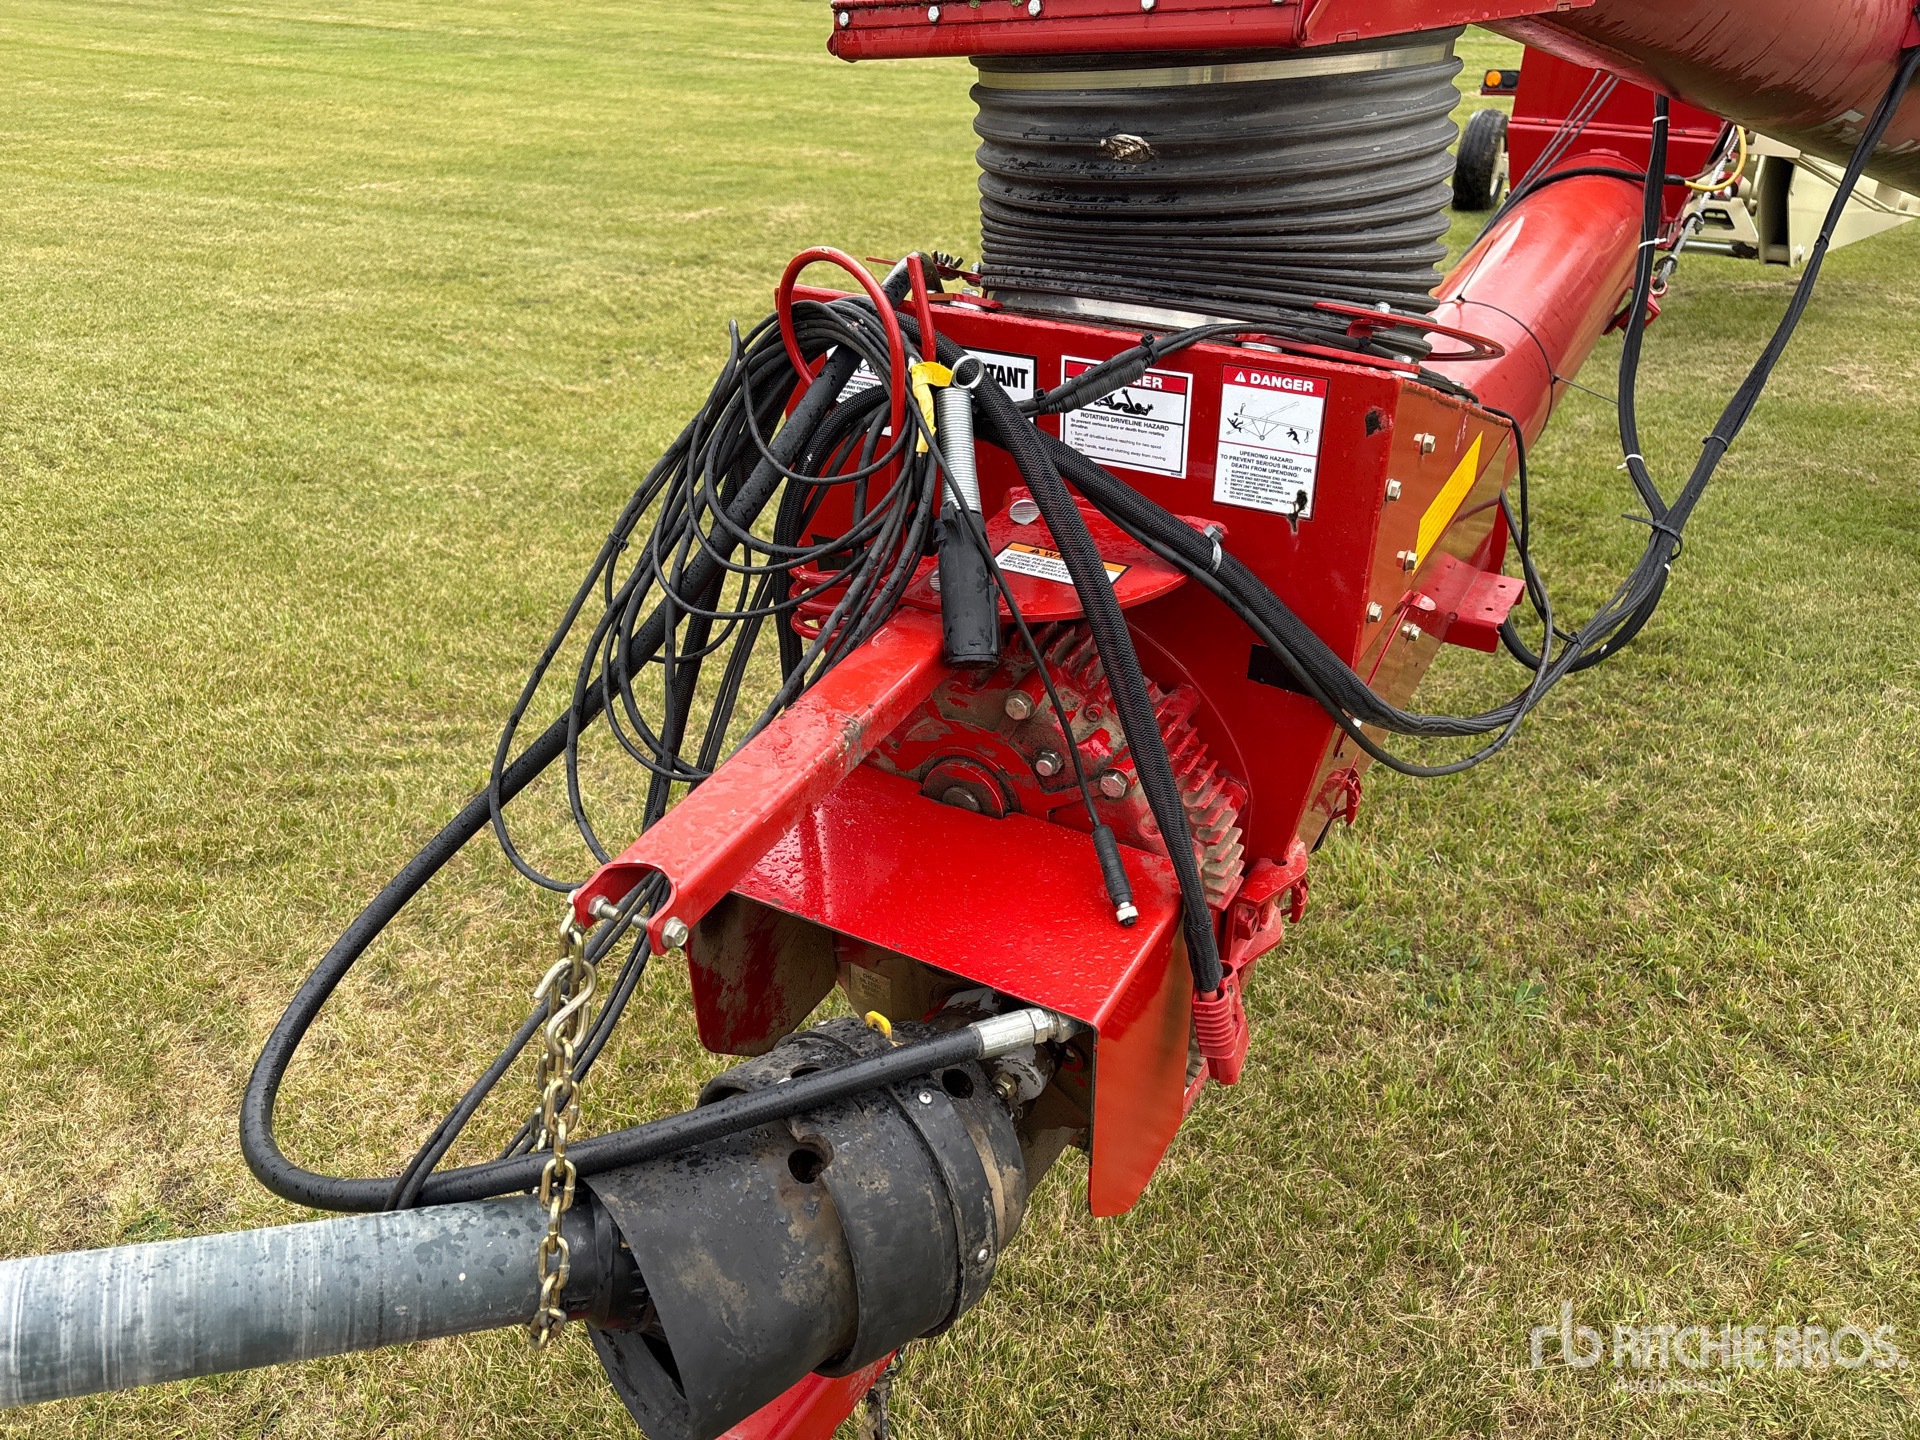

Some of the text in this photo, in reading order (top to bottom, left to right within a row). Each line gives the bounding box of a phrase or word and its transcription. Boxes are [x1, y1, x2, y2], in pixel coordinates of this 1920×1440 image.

[1250, 372, 1314, 392] DANGER
[1080, 412, 1169, 431] ROTATING DRIVELINE HAZARD
[1229, 456, 1254, 464] PREVENT
[1256, 460, 1280, 468] SERIOUS
[1240, 450, 1294, 464] UPENDING HAZARD
[1231, 462, 1250, 470] DEATH
[1268, 468, 1299, 478] UPENDING:
